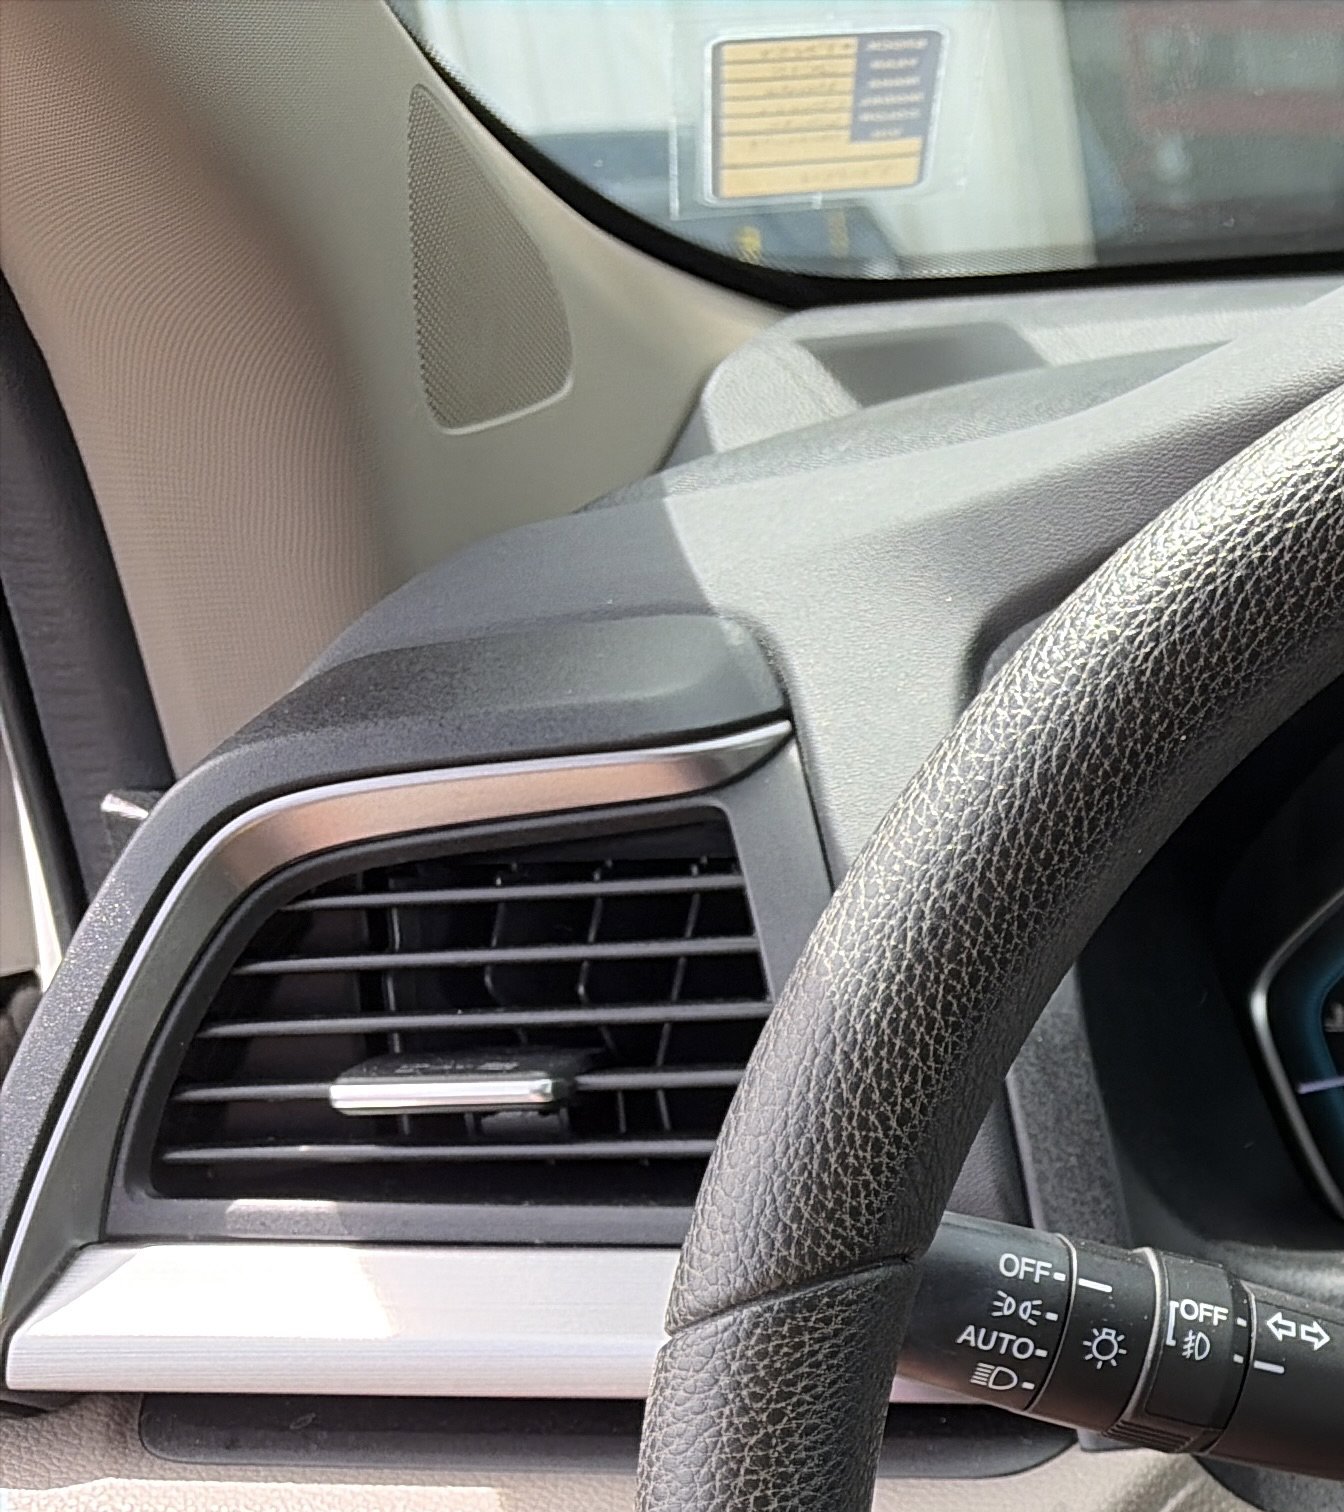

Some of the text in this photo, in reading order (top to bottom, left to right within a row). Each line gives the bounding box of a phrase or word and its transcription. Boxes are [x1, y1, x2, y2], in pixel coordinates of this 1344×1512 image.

[1000, 1253, 1052, 1285] OFF
[1180, 1299, 1229, 1327] OFF
[957, 1325, 1035, 1360] AUTO
